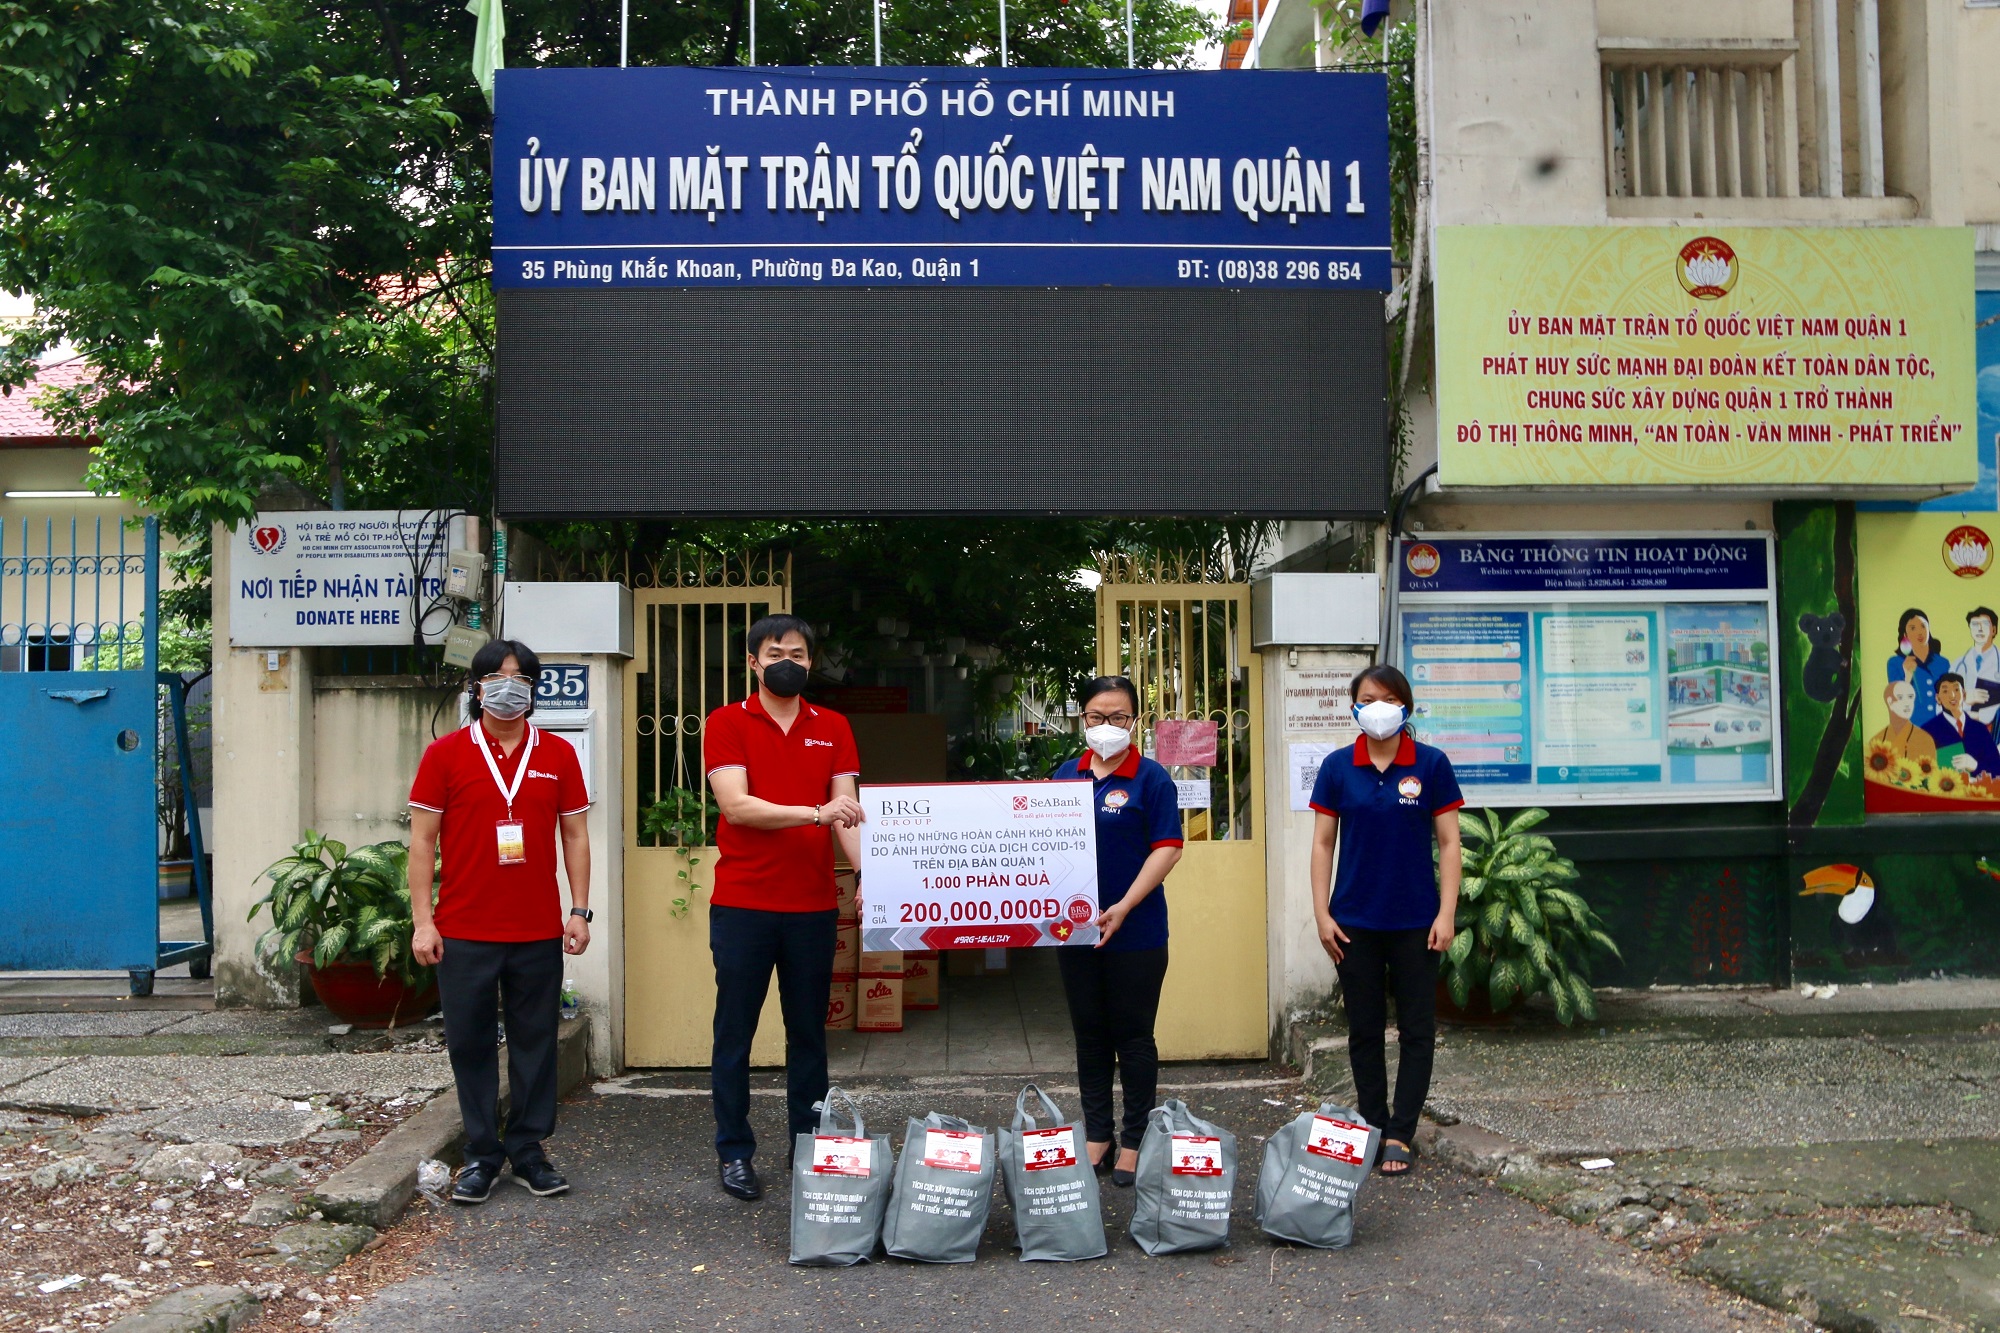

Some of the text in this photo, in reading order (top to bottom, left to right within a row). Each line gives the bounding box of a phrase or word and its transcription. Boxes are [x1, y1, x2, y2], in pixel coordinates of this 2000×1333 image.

[706, 80, 1174, 117] THÀNH PHỐ HỒ CHÍ MINH
[520, 128, 1365, 224] ỦY BAN MẶT TRẬN TỔ QUỐC VIỆT NAM QUẬN 1
[522, 256, 978, 283] 35 Phùng Khắc Khoan, Phường Đa Kao, Quận 1
[1178, 260, 1362, 283] ĐT: (08)38 296 854
[1509, 309, 1907, 340] ỦY BAN MẶT TRẬN TỔ QUỐC VIỆT NAM QUẬN 1
[1483, 351, 1935, 379] PHÁT HUY SỨC MẠNH ĐẠI ĐOÀN KẾT TOÀN DÂN TỘC,
[1527, 384, 1892, 413] CHUNG SỨC XÂY DỰNG QUẬN 1 TRỞ THÀNH
[1457, 415, 1961, 447] ĐÔ THỊ THÔNG MINH, “AN TOÀN VĂN MINH PHÁT TRIỂN”
[296, 521, 389, 532] HỘI BẢO TRỢ NGƯỜI
[298, 531, 397, 542] VÀ TRẺ MỒ CÔI TP.HỒ
[1460, 543, 1747, 565] BẢNG THÔNG TIN HOẠT ĐỘNG
[242, 577, 272, 599] NƠI
[279, 569, 317, 599] TIẾP
[324, 574, 378, 602] NHẬN
[384, 572, 413, 597] TÀI
[296, 610, 400, 625] DONATE HERE
[537, 669, 585, 697] 35
[882, 800, 930, 815] BRG
[1030, 797, 1082, 808] SeABank
[880, 818, 932, 827] GROUP
[918, 830, 958, 841] NHỮNG
[961, 828, 992, 840] HOÀN
[995, 828, 1026, 839] CẢNH
[1029, 827, 1053, 838] KHÓ
[1056, 826, 1086, 837] KHĂN
[871, 841, 1086, 857] DO ẢNH HƯỞNG CỦA DỊCH COVID-19
[912, 856, 1044, 870] TRÊN ĐỊA BÀN QUẬN 1
[922, 870, 1050, 889] 1.000 PHẦN QUÀ
[872, 905, 886, 914] TRỊ
[872, 915, 887, 924] GIÁ
[900, 899, 1060, 924] 200,000,000Đ
